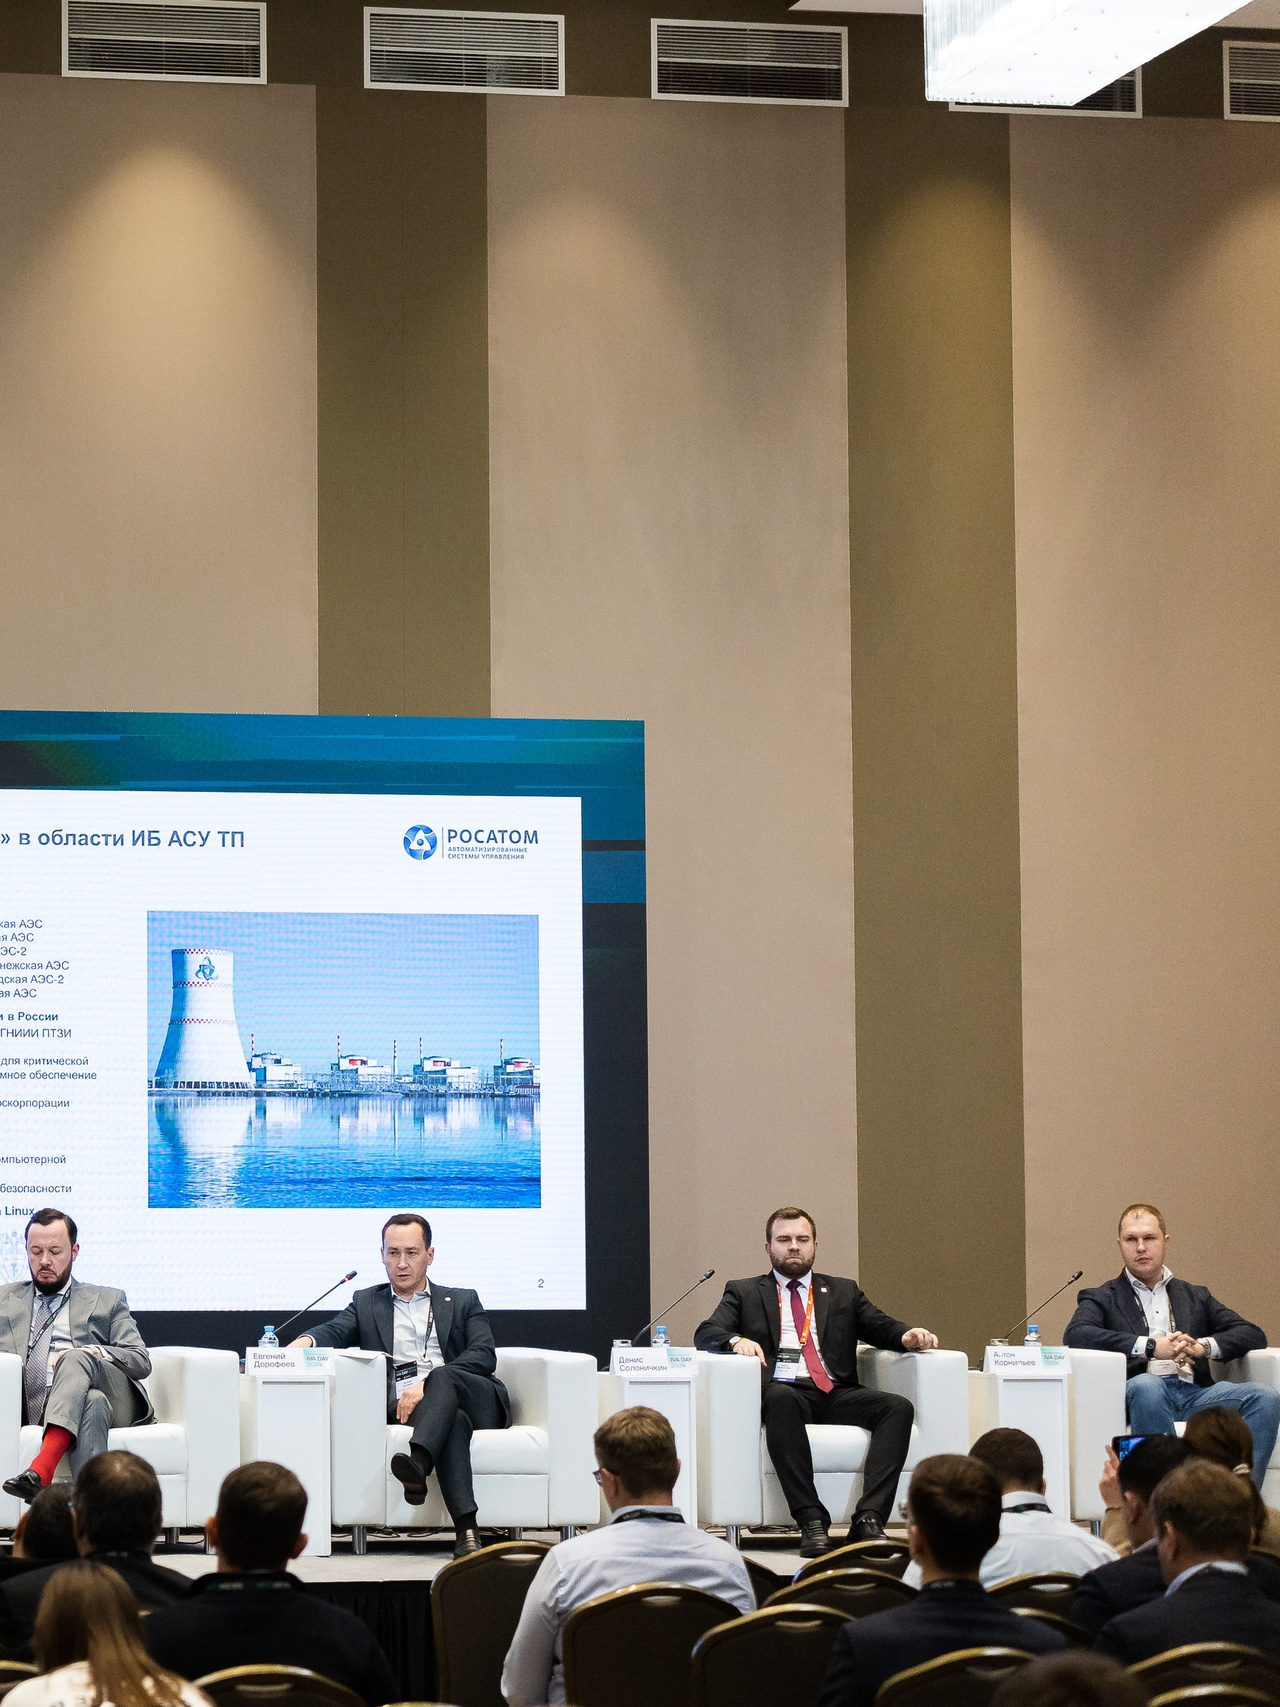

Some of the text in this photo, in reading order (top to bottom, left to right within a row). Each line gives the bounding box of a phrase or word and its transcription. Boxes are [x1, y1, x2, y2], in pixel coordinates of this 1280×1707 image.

[19, 833, 30, 845] в
[38, 830, 124, 846] области
[132, 830, 161, 846] ИБ
[168, 831, 210, 847] АСУ
[218, 831, 244, 847] ТП
[448, 829, 538, 844] РОСАТОМ
[19, 919, 42, 929] АЭС
[11, 932, 34, 942] АЭС
[46, 960, 69, 971] АЭС
[31, 974, 64, 984] АЭС-2
[13, 988, 36, 998] АЭС
[18, 1012, 58, 1022] России
[43, 1029, 71, 1039] ПТЗИ
[1, 1058, 20, 1067] для
[24, 1057, 88, 1068] критической
[29, 1070, 97, 1080] обеспечение
[0, 1183, 71, 1194] безопасности
[5, 1206, 35, 1216] Linux
[538, 1279, 545, 1288] 2
[253, 1352, 286, 1360] Евгений
[619, 1356, 644, 1364] Денис
[254, 1361, 296, 1369] Дорофеев
[619, 1364, 668, 1372] Солоничкин
